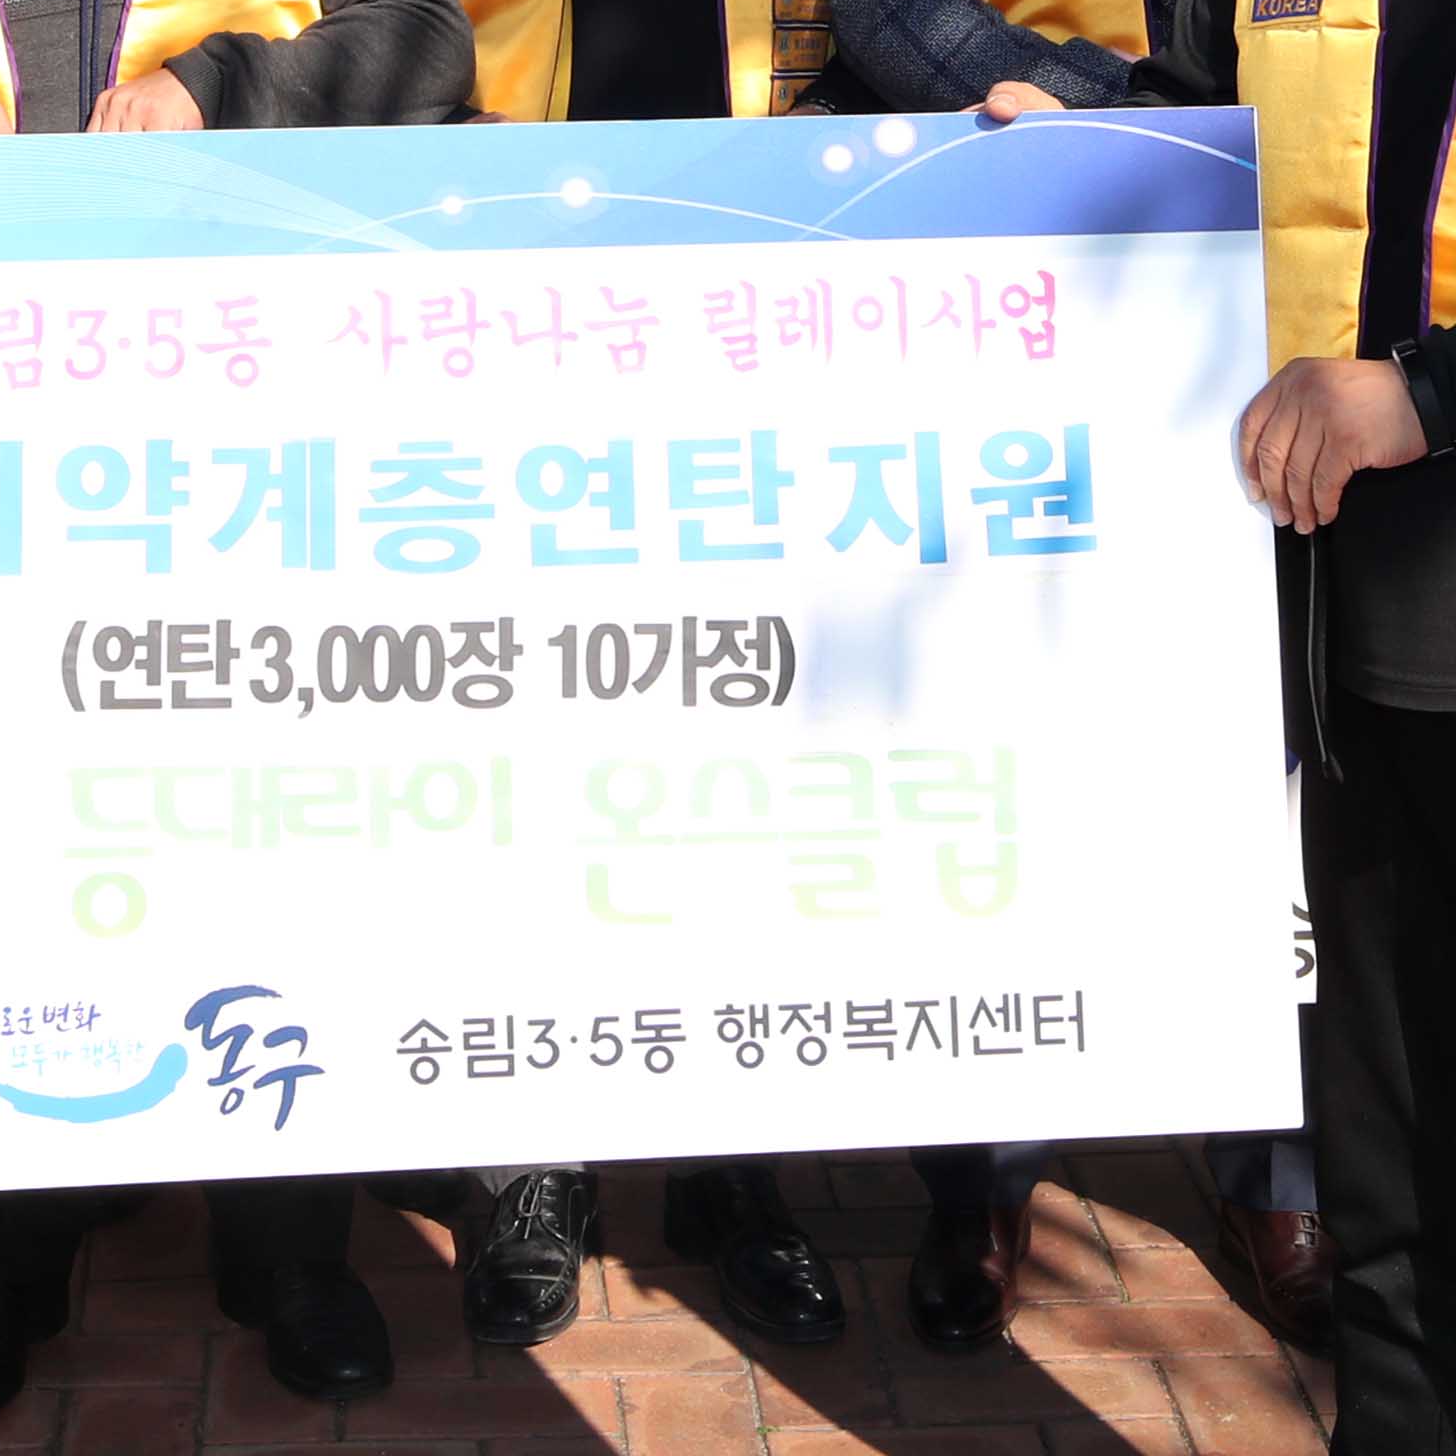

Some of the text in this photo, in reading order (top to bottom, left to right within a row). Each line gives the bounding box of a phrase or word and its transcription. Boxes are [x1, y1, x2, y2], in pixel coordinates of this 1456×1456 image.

[328, 286, 659, 377] 사랑나눔
[703, 269, 1057, 373] 릴레이사업
[61, 615, 796, 719] (연탄3,000장 10가정)
[184, 985, 325, 1131] 동구
[713, 989, 1086, 1069] 행정복지센터
